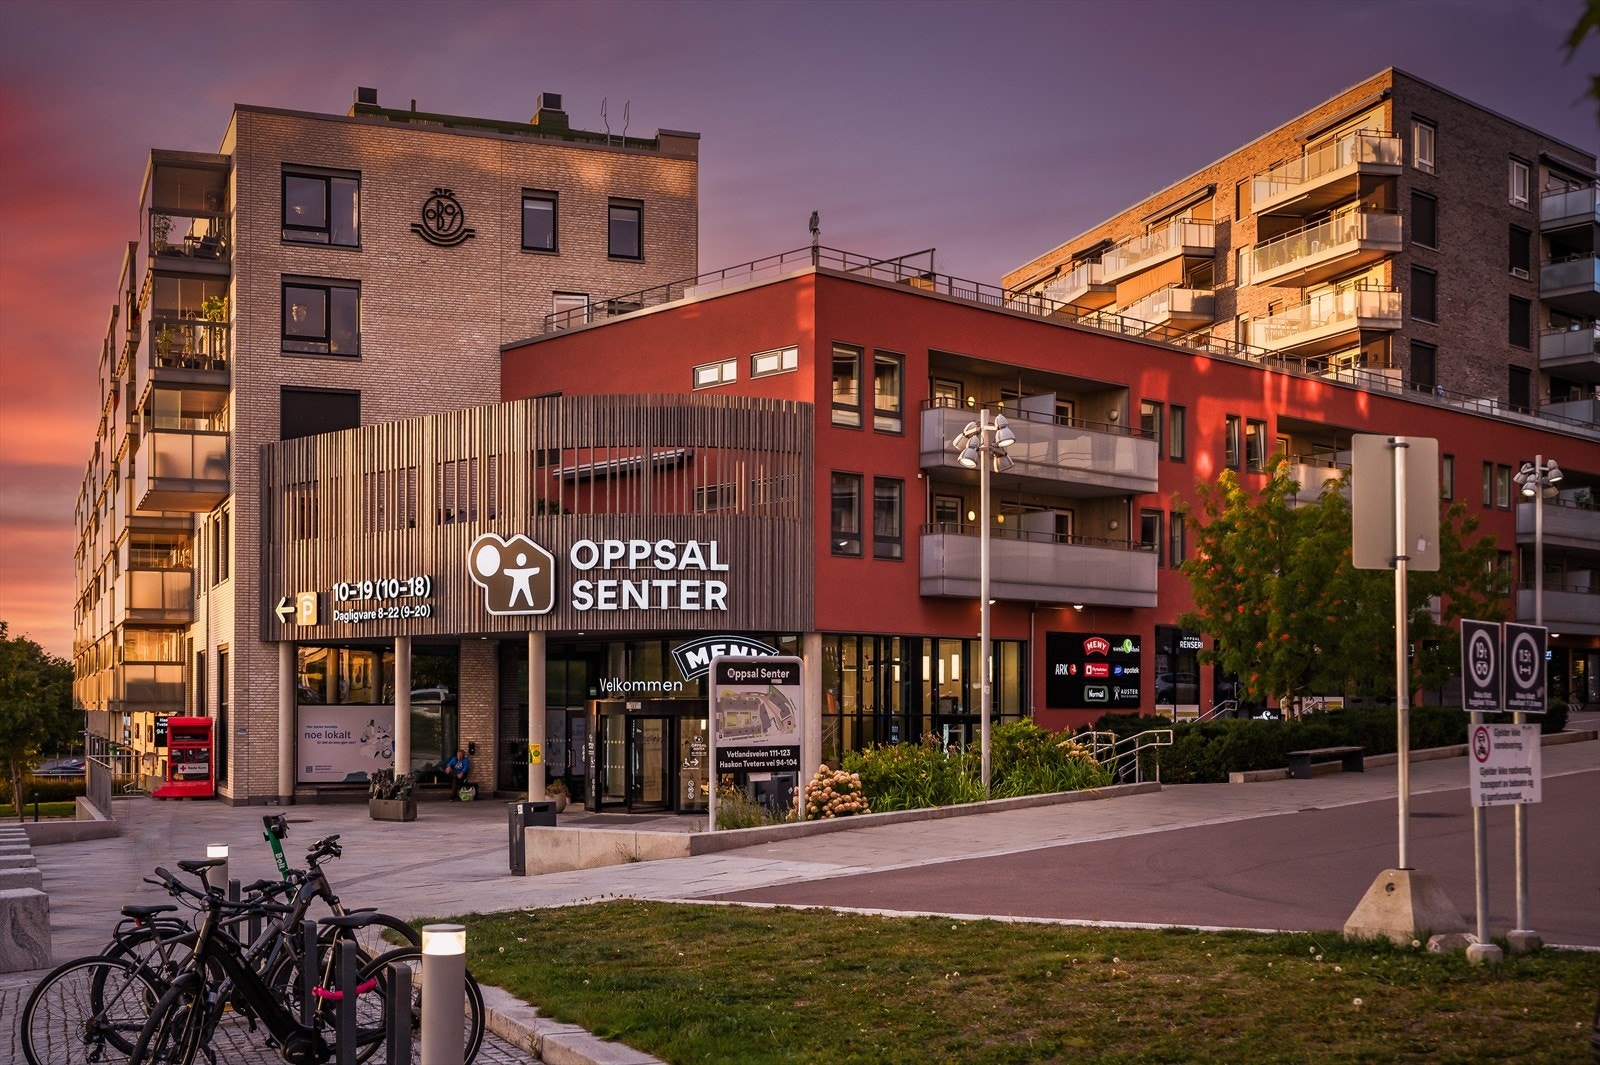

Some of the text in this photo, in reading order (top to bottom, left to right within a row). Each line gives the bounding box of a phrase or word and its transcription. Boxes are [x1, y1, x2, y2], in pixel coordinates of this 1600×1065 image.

[570, 539, 729, 571] OPPSAL
[572, 579, 728, 611] SENTER
[334, 608, 376, 623] Dagligvare
[1086, 640, 1107, 650] MENY
[1180, 641, 1204, 649] RENSERI
[727, 668, 790, 681] Oppsal Senter
[1055, 664, 1068, 675] ARK
[1124, 666, 1140, 674] apotek
[599, 678, 683, 692] Velkommen
[1088, 689, 1104, 698] Normal
[325, 730, 352, 739] lokalt
[726, 749, 791, 758] Vetlandsveien 111-123
[776, 758, 798, 766] 94-104
[275, 852, 286, 870] Bolt
